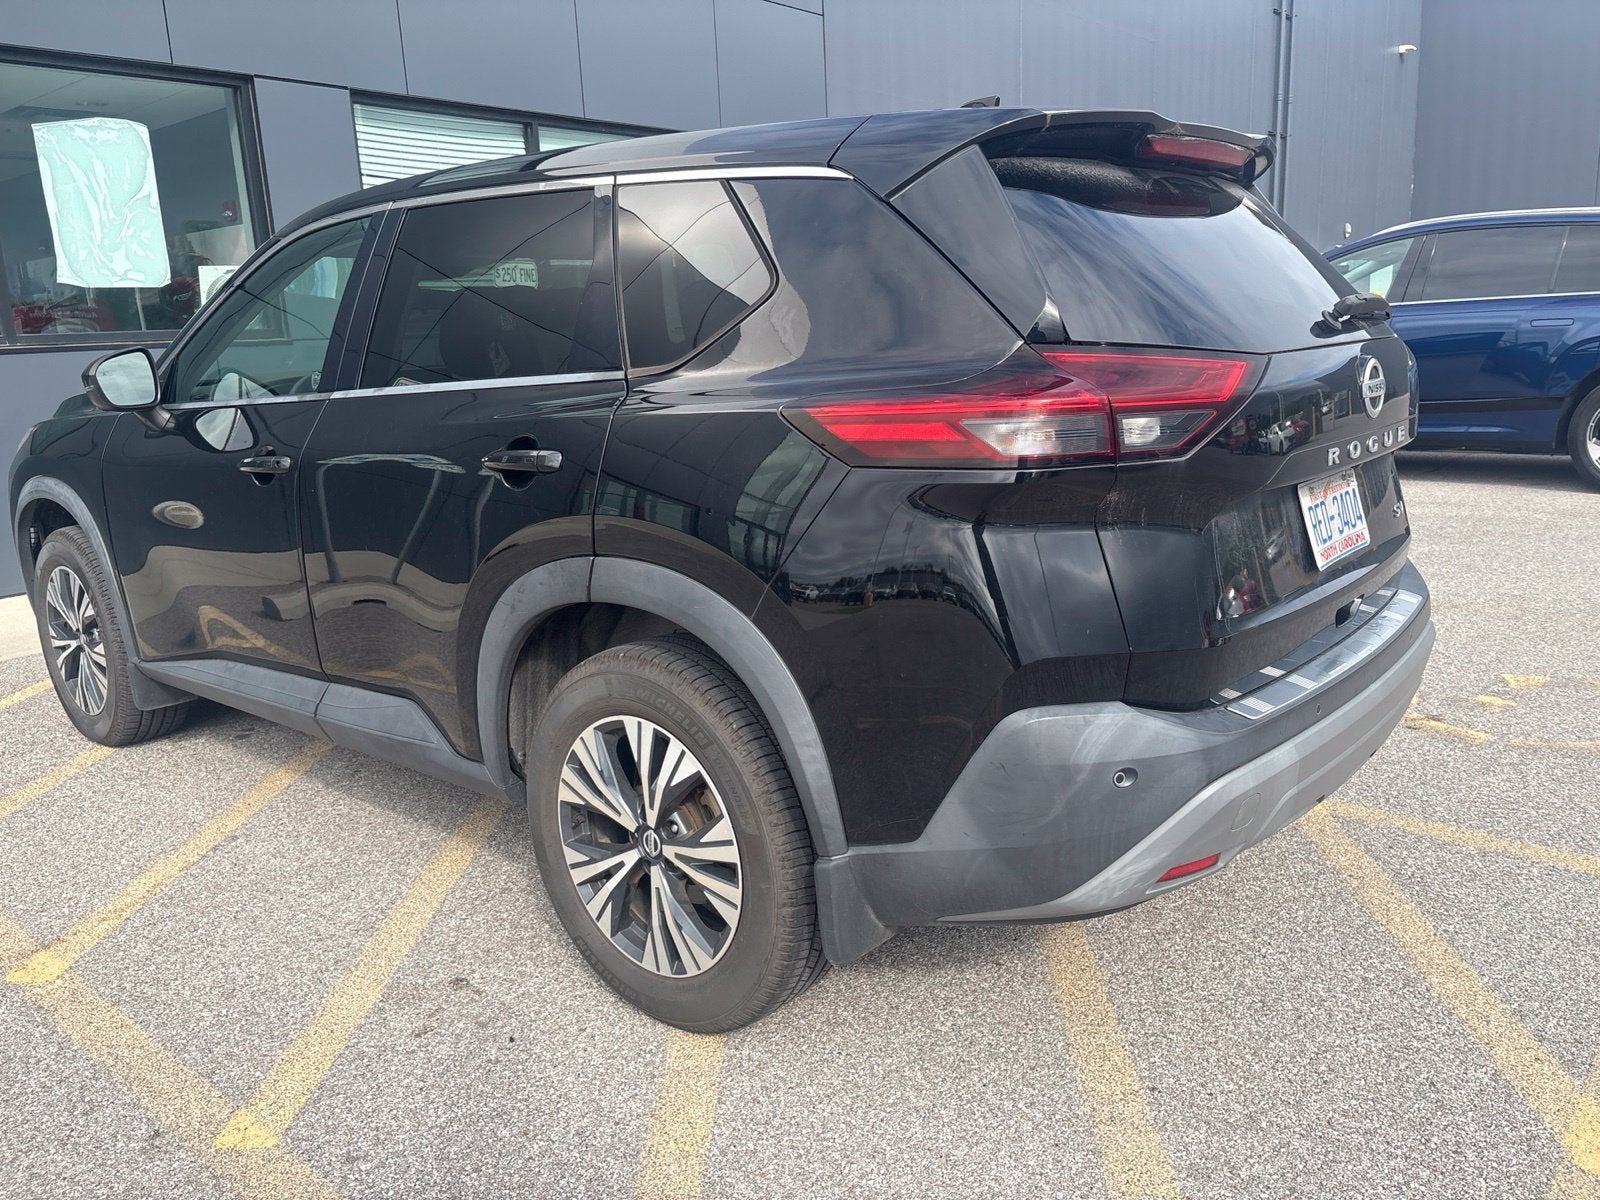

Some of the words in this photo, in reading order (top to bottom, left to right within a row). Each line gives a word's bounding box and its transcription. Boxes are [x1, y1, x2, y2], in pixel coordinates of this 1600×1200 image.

[520, 267, 536, 283] FINE
[1327, 425, 1406, 467] ROGUE
[1307, 487, 1364, 548] RED-3404
[1320, 543, 1338, 562] NORTH
[1338, 531, 1366, 553] CAROLINA
[635, 687, 710, 747] MICHELIN
